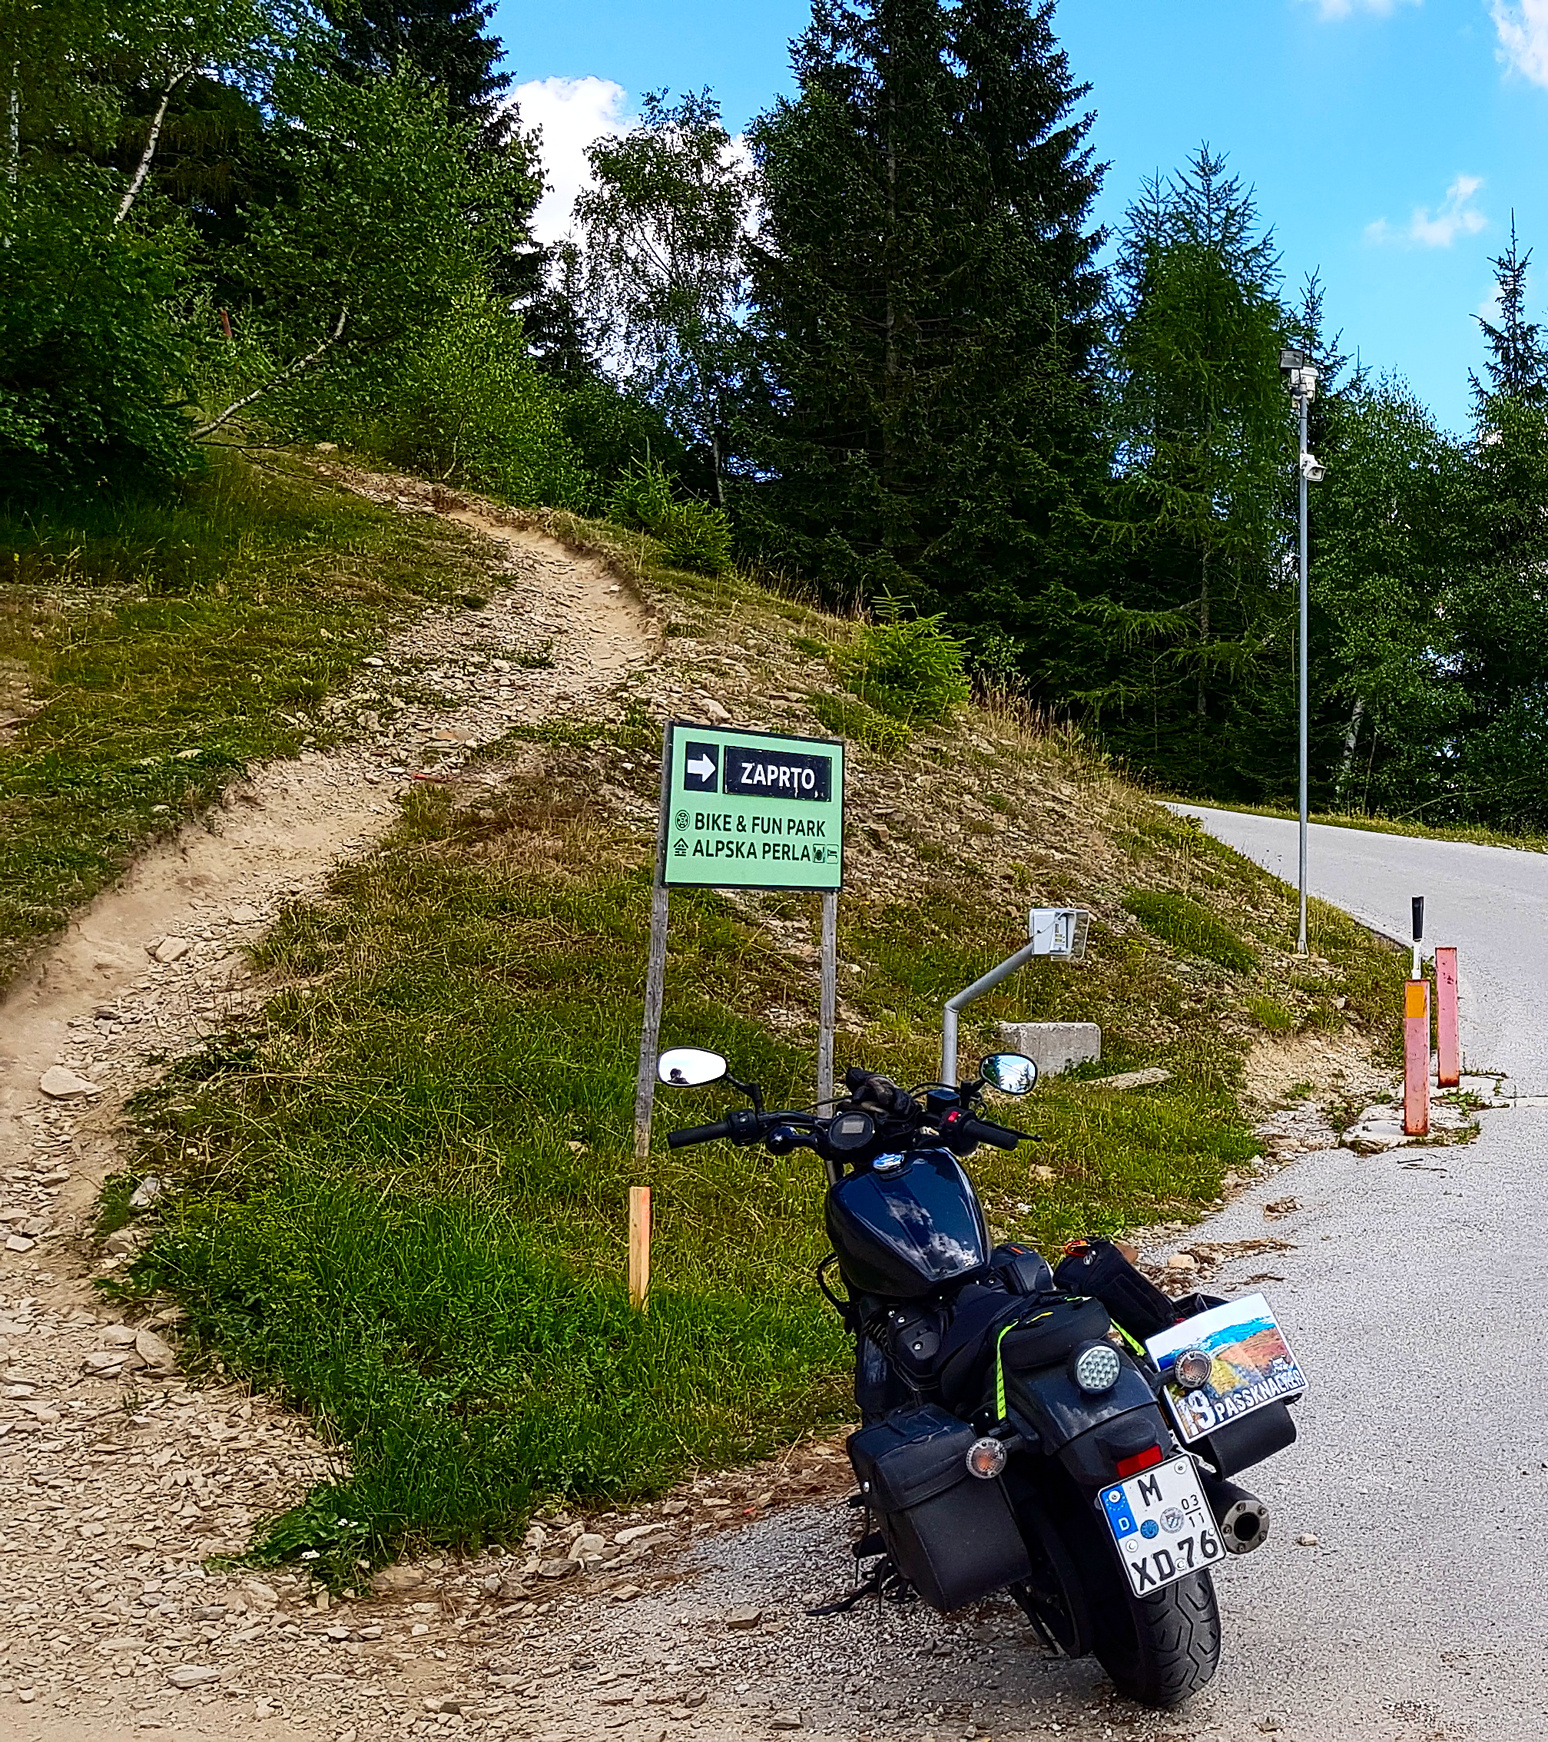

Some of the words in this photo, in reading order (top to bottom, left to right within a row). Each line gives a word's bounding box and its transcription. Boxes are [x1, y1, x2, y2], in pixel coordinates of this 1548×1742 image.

[741, 762, 816, 789] ZAPRTO
[694, 812, 732, 832] BIKE
[736, 814, 747, 832] &
[751, 816, 782, 835] FUN
[787, 818, 826, 837] PARK
[692, 839, 757, 859] ALPSKA
[762, 842, 811, 862] PERLA
[1214, 1369, 1305, 1422] PASSKNACKER
[1137, 1473, 1163, 1507] M
[1181, 1494, 1199, 1510] 03
[1118, 1516, 1130, 1531] D
[1188, 1512, 1205, 1528] 11
